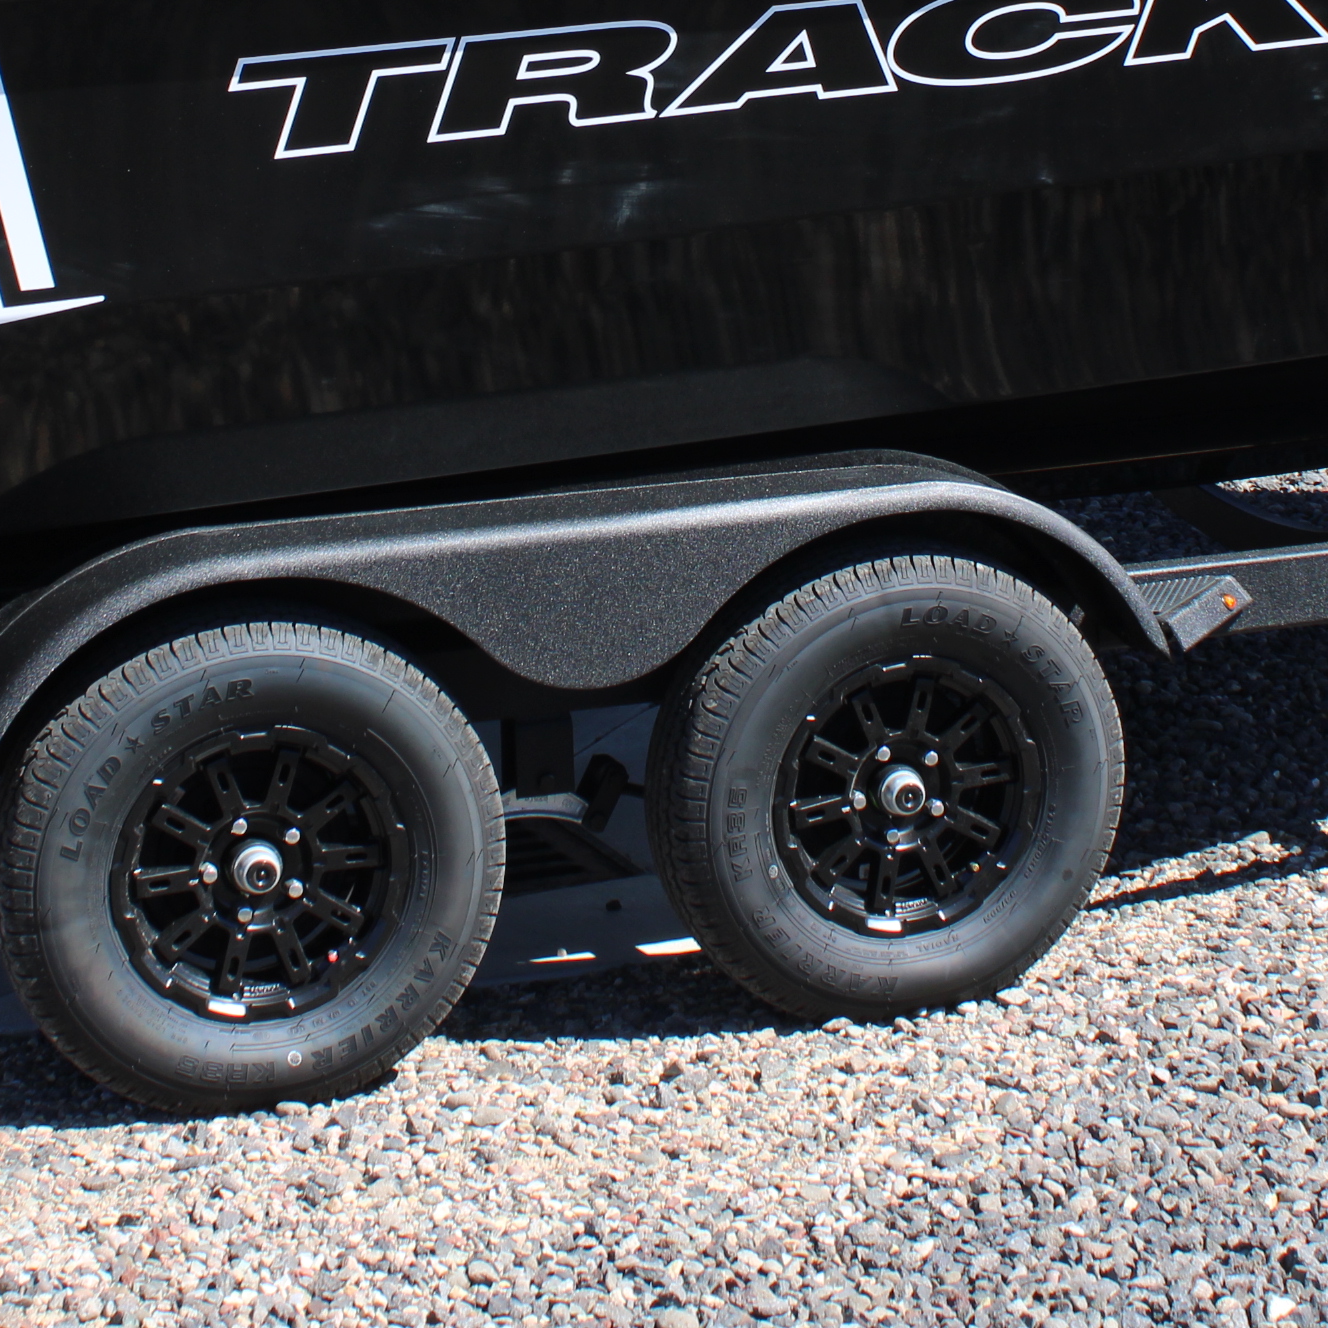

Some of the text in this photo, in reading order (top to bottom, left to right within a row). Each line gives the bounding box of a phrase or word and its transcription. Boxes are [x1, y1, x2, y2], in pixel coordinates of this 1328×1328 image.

[900, 604, 1083, 726] LOAD STAR
[59, 677, 254, 863] LOAD STAR
